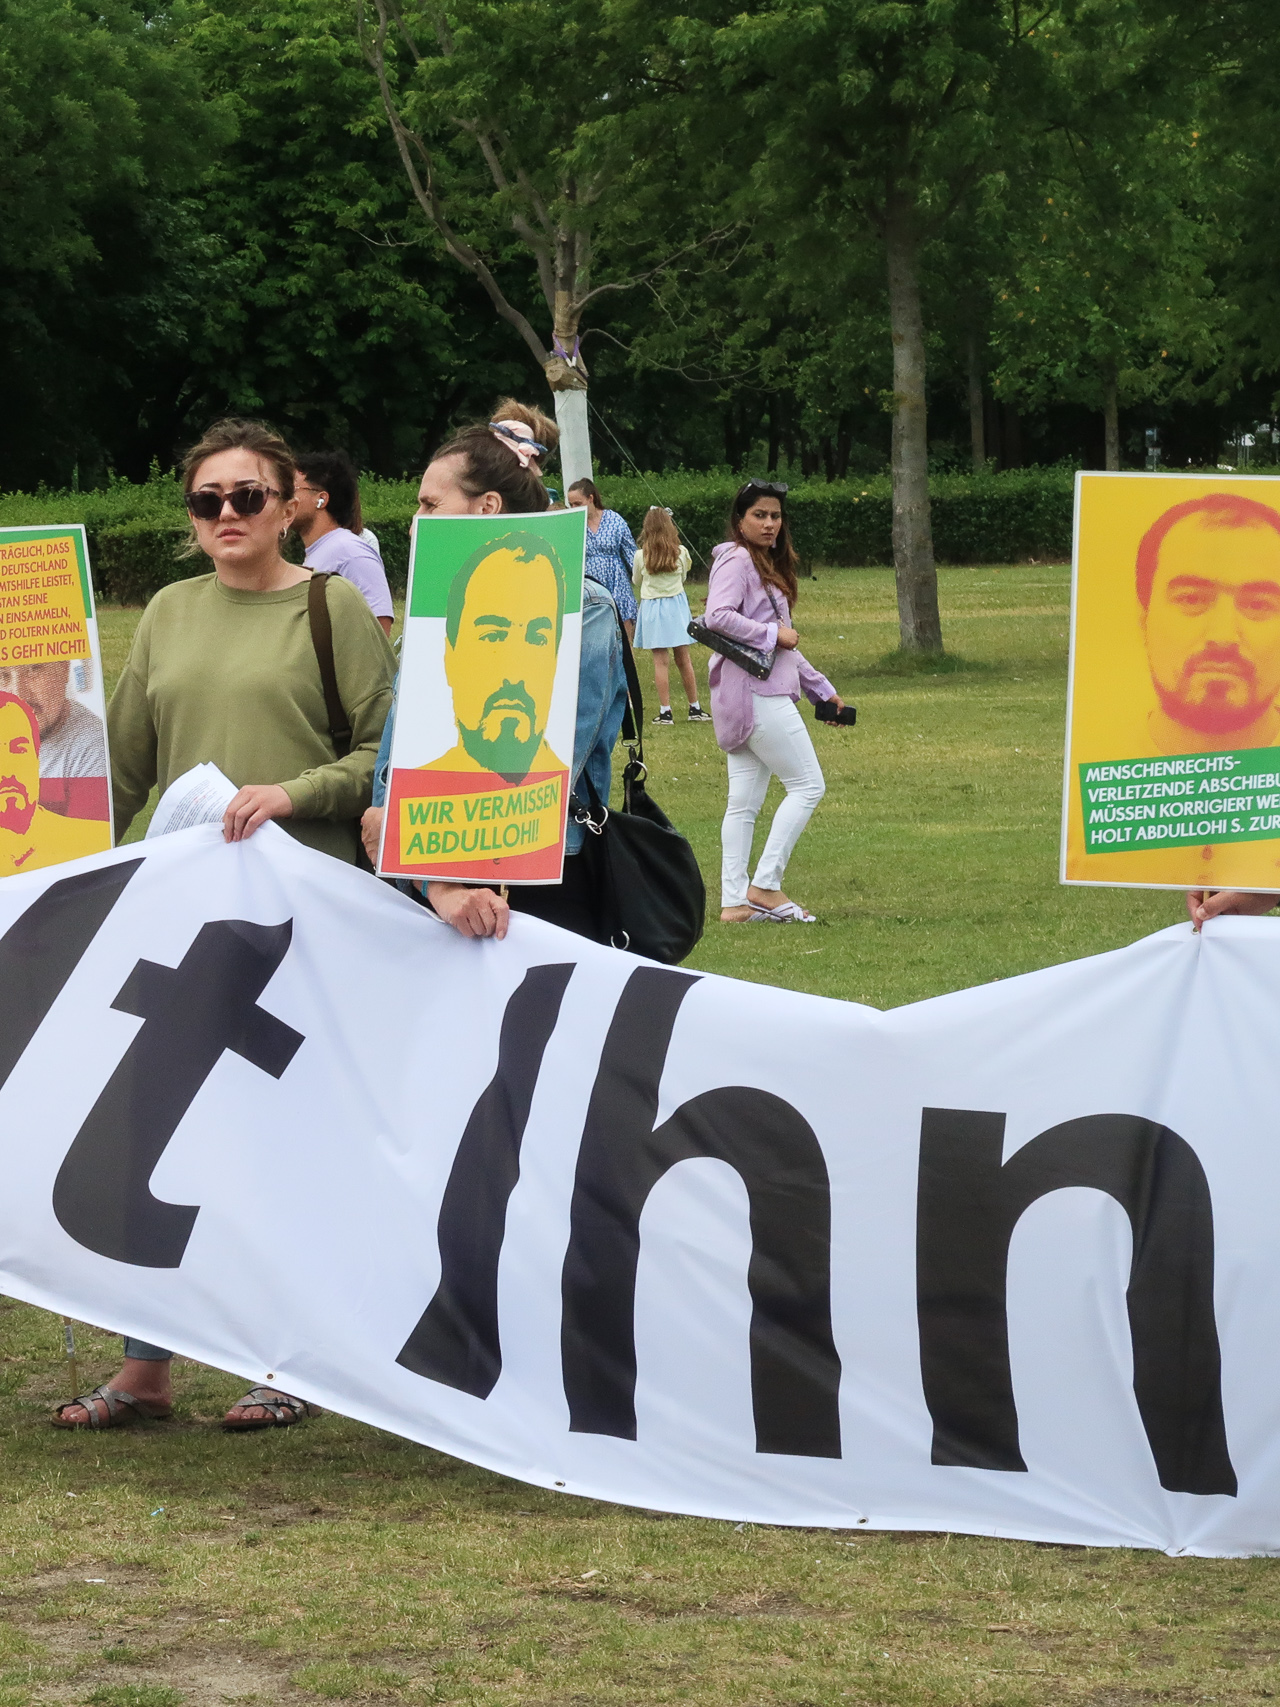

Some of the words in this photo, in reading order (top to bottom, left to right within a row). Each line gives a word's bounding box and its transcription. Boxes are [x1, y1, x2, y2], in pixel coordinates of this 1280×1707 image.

[46, 542, 70, 555] DASS
[1, 558, 68, 576] DEUTSCHLAND
[41, 573, 75, 587] LEISTET,
[22, 592, 48, 606] SEINE
[6, 606, 71, 624] EINSAMMELN,
[9, 623, 50, 639] FOLTERN
[51, 621, 83, 635] KANN.
[11, 642, 43, 659] GEHT
[46, 639, 86, 656] NICHT!
[1085, 755, 1241, 783] MENSCHENRECHTS-
[1087, 780, 1195, 803] VERLETZENDE
[407, 801, 454, 825] WIR
[463, 781, 559, 822] VERMISSEN
[1088, 804, 1156, 825] MÜSSEN
[1159, 796, 1255, 818] KORRIGIERT
[405, 818, 540, 856] ABDULLOHI!
[1090, 827, 1133, 845] HOLT
[1134, 818, 1227, 841] ABDULLOHI
[1230, 817, 1245, 833] S.
[396, 962, 1238, 1497] Ihn
